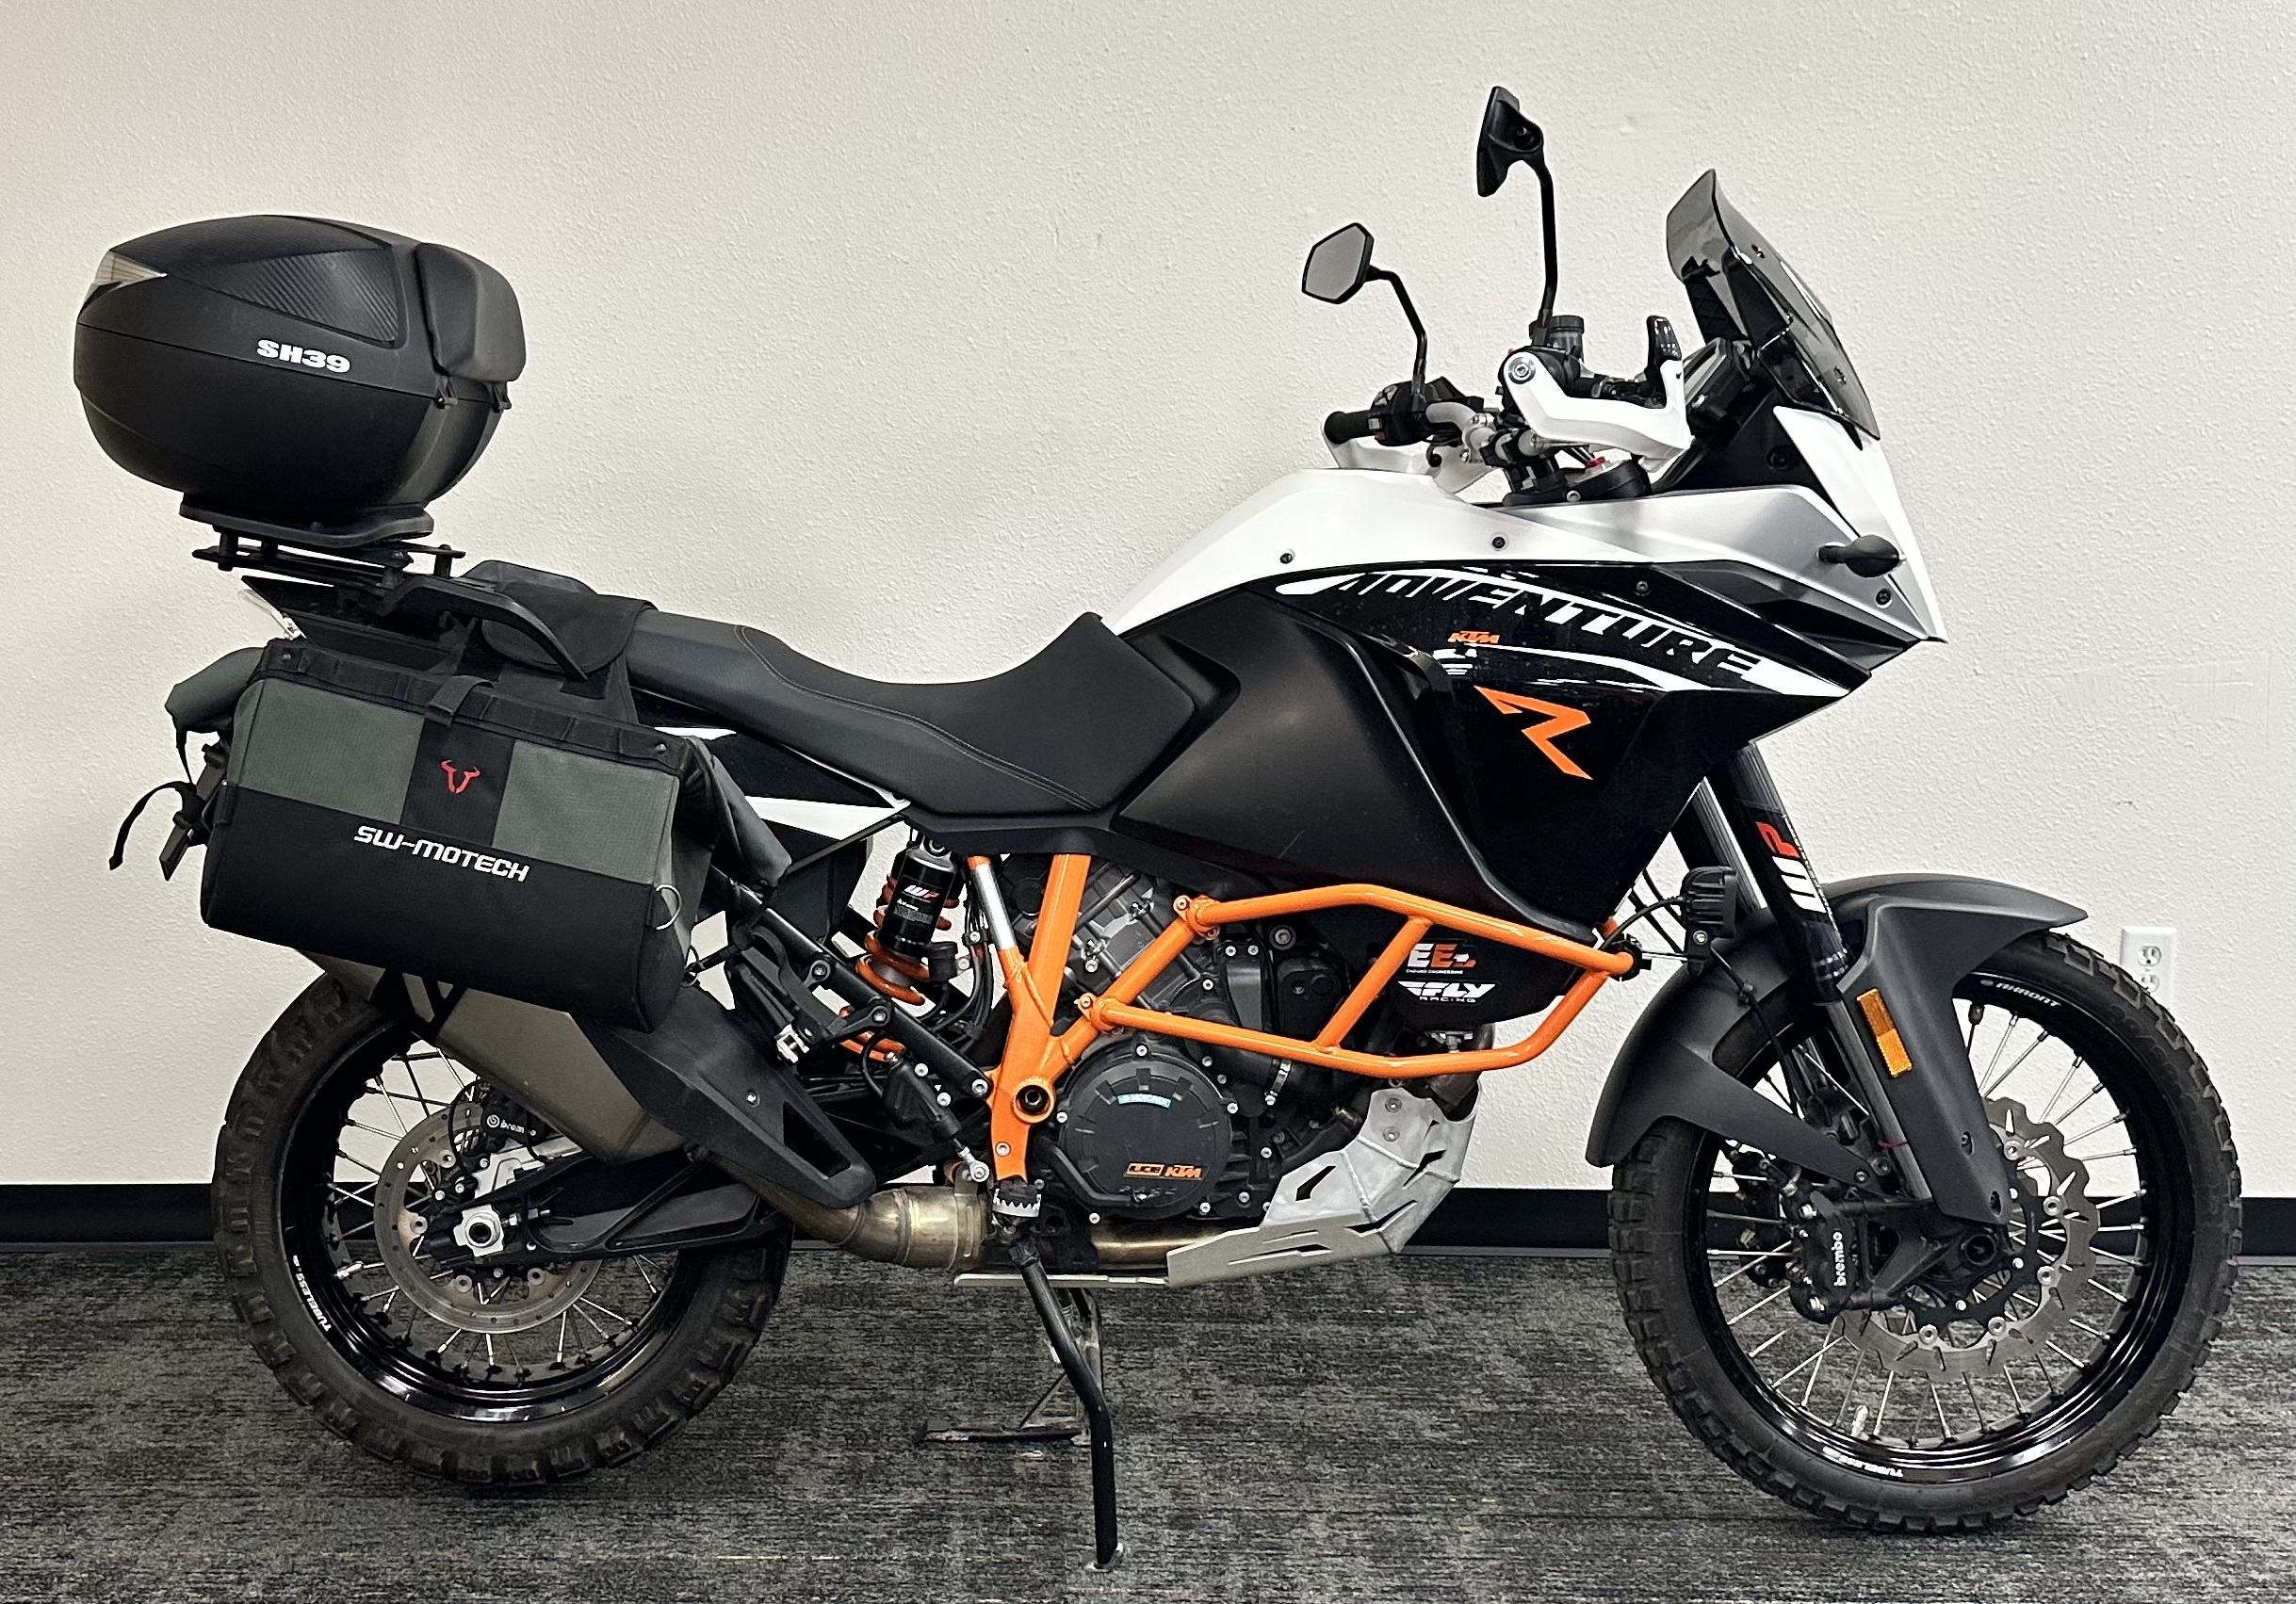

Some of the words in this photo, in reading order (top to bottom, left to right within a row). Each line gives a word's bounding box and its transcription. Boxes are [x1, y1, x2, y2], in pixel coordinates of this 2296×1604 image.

[256, 339, 350, 373] SH39
[1315, 572, 1762, 680] ADVENTURE
[1447, 630, 1500, 644] KTM
[353, 825, 529, 883] SW-MOTECH
[1756, 821, 1827, 914] WP
[904, 884, 940, 899] WP
[500, 1119, 537, 1137] bremo
[1164, 1164, 1202, 1179] KTM
[1831, 1231, 1847, 1287] brembo
[296, 1272, 332, 1332] TUBELESS
